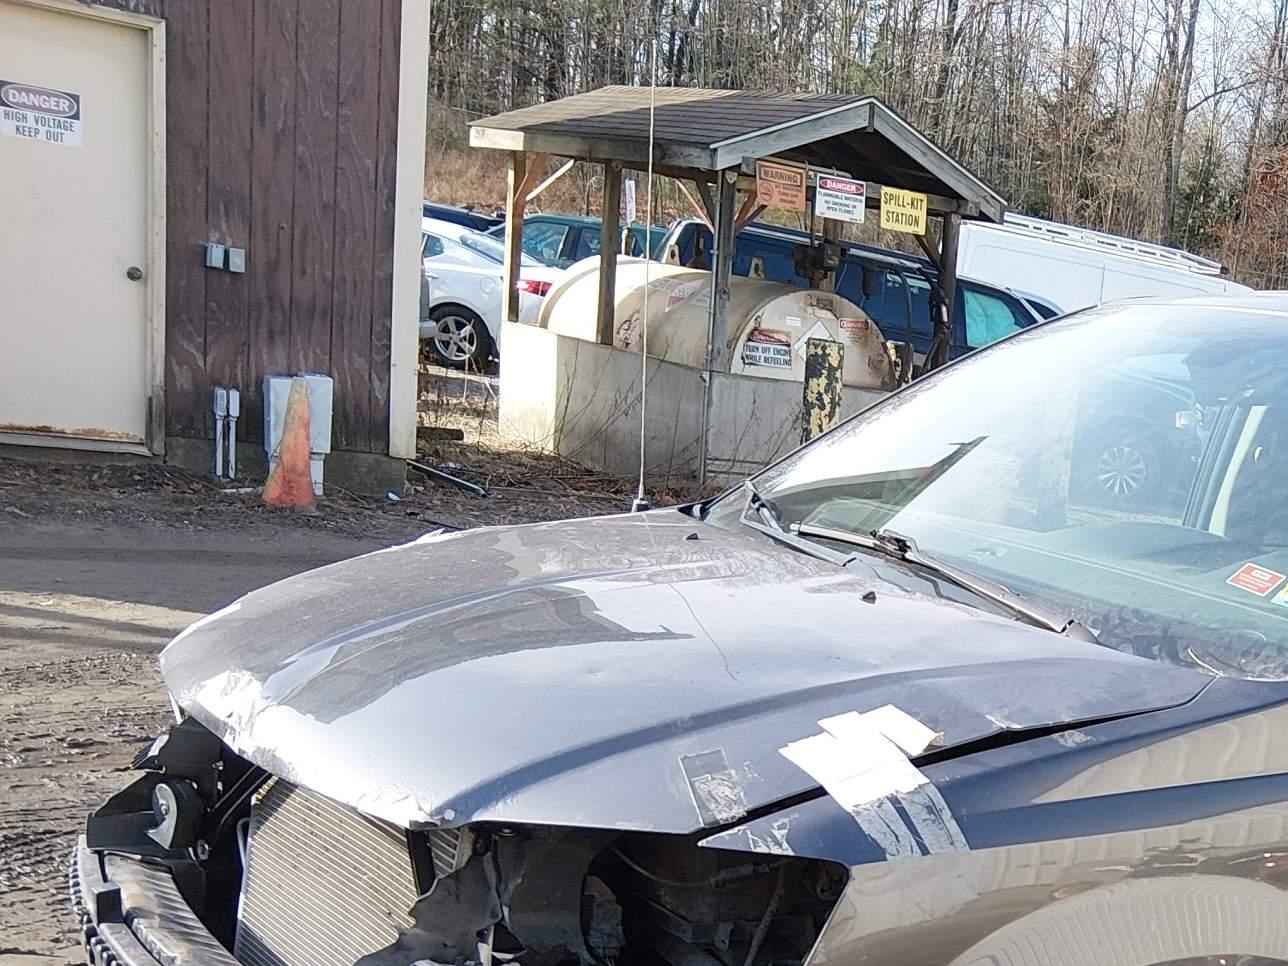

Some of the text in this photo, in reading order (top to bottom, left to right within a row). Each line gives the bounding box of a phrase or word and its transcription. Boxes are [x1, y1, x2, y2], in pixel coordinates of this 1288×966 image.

[8, 88, 70, 112] DANGER
[4, 110, 76, 132] HIGH VOLTAGE
[16, 125, 64, 143] KEEP OUT
[763, 168, 798, 184] WARNING
[826, 179, 856, 193] DANGER
[883, 192, 924, 211] SPILL-KIT
[885, 210, 920, 228] STATION
[746, 345, 759, 353] TURN
[761, 346, 771, 354] OFF
[745, 353, 792, 366] WHILE REFUELING
